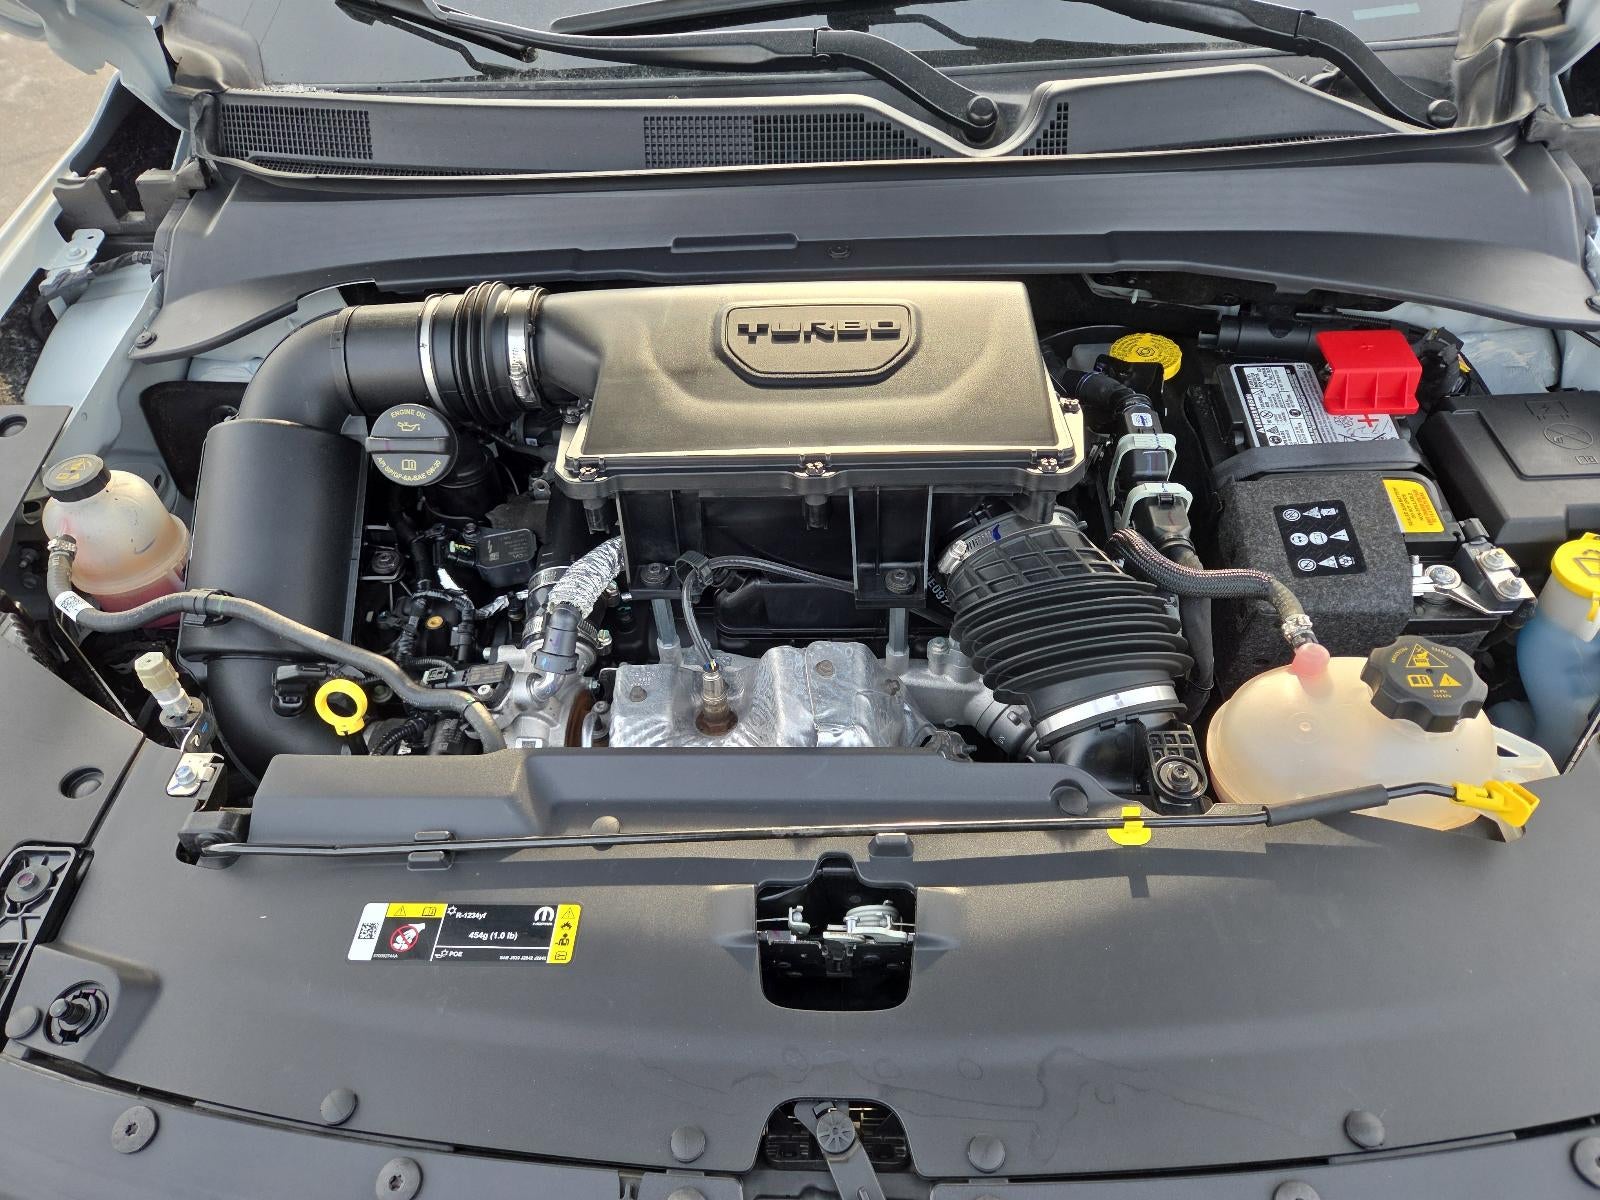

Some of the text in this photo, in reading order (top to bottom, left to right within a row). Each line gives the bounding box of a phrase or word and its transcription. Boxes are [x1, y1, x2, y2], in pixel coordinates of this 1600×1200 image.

[736, 320, 900, 344] TURBO
[391, 409, 426, 419] ENGINE OIL
[377, 457, 387, 468] API
[455, 911, 487, 920] R-1234yf
[468, 931, 518, 941] 454g (1.0 lb)
